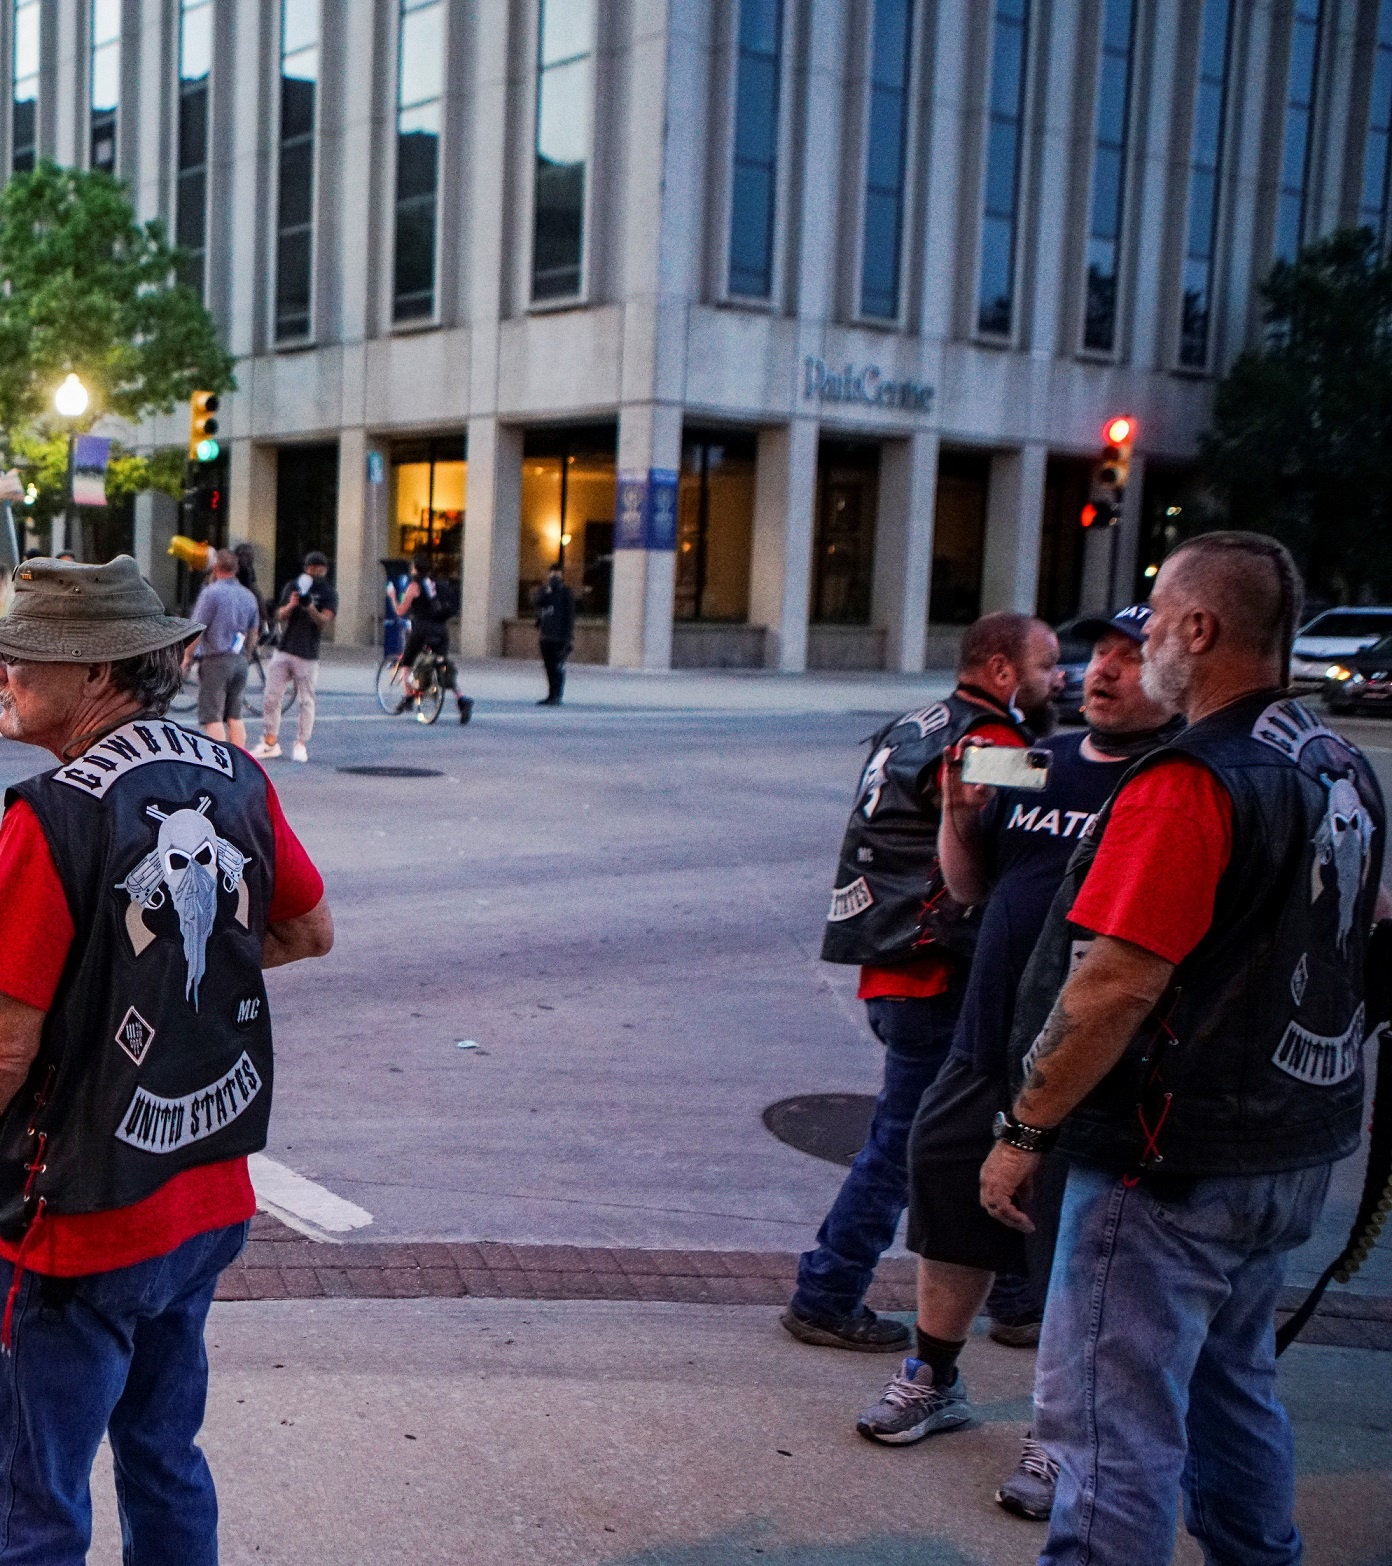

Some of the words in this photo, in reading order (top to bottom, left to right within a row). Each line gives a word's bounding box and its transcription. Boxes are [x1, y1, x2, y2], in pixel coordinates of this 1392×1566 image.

[63, 724, 229, 790] COWBOYS
[237, 997, 260, 1023] MC
[125, 1092, 185, 1150] UNITED
[190, 1058, 258, 1138] STATES
